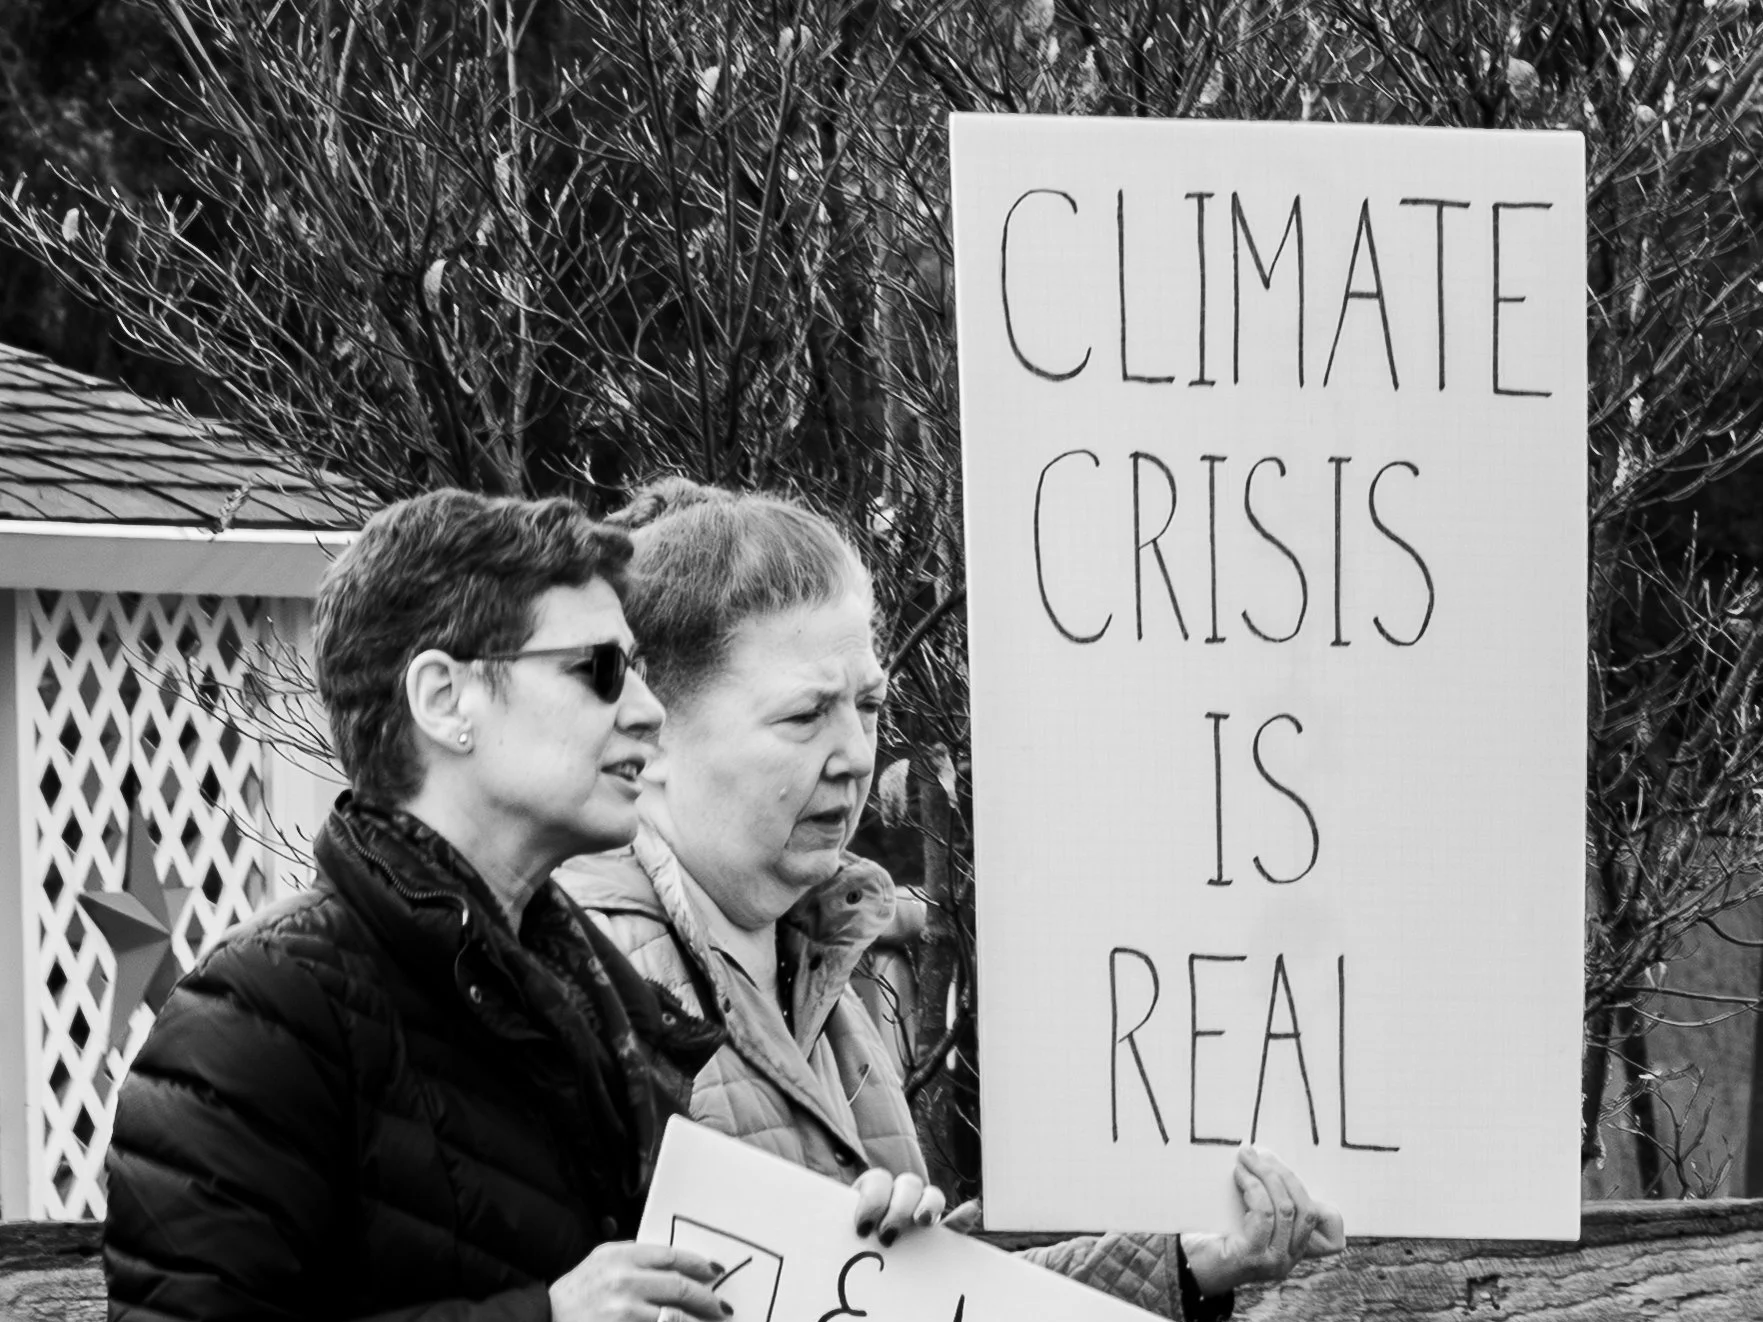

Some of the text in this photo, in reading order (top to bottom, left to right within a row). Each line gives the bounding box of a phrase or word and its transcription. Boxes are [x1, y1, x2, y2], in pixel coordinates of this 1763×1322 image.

[1002, 190, 1553, 398] CLIMATE
[1033, 449, 1435, 647] CRISIS
[1204, 711, 1320, 887] IS
[1109, 946, 1400, 1151] REAL
